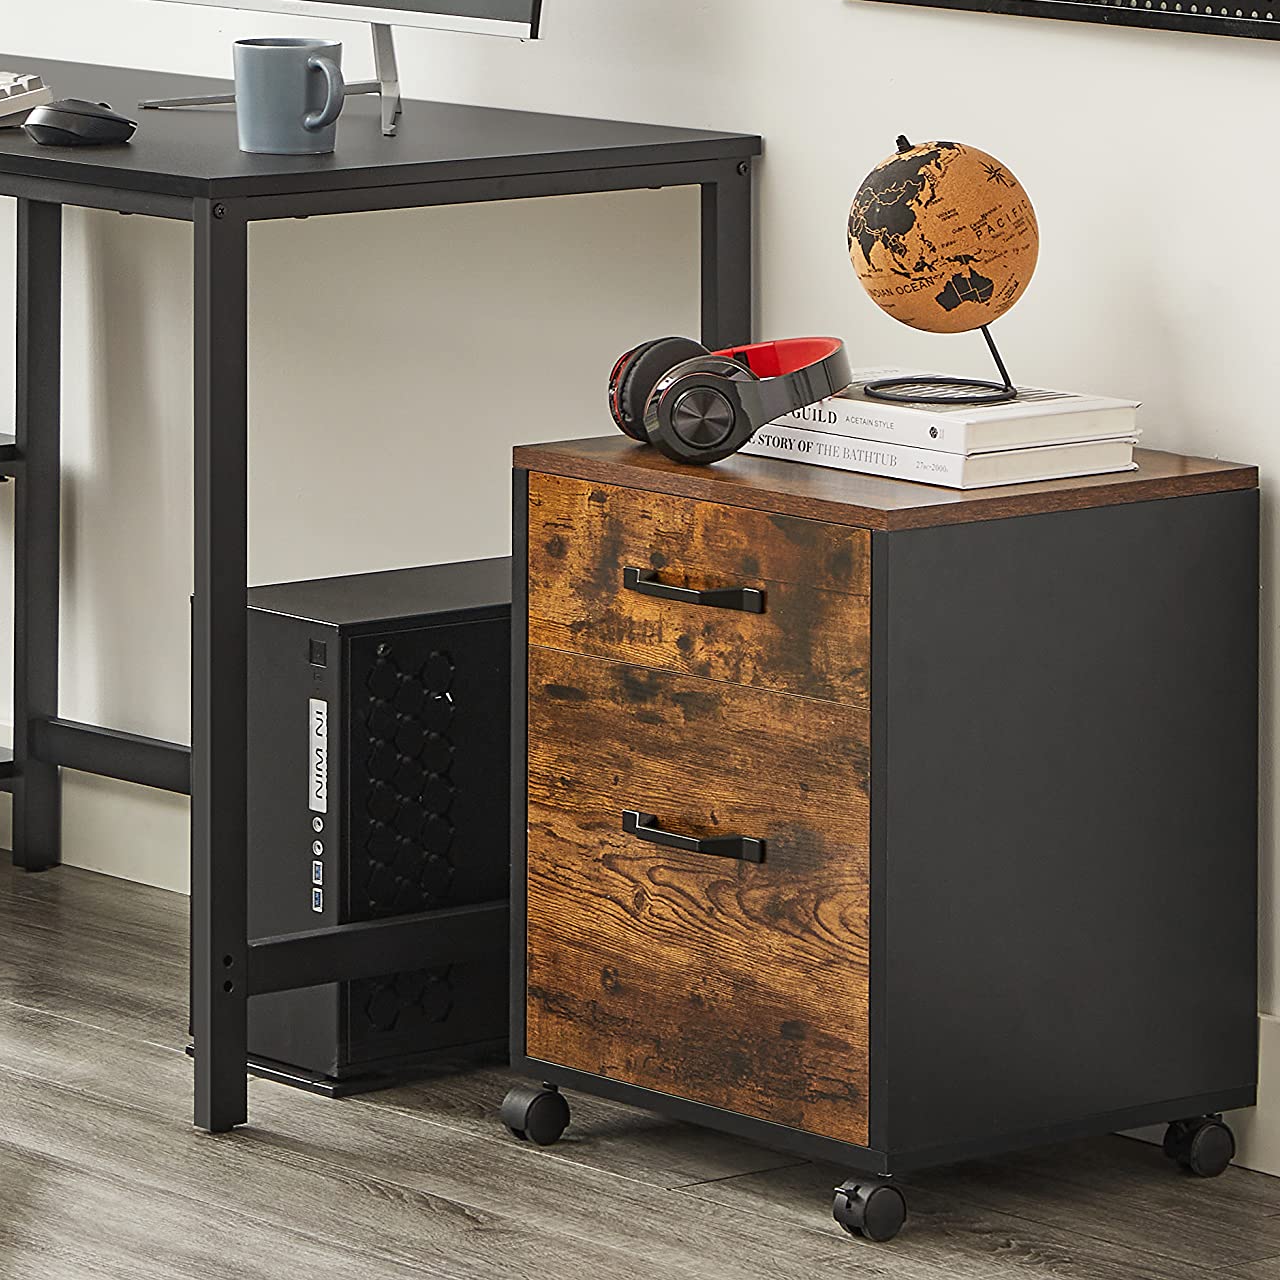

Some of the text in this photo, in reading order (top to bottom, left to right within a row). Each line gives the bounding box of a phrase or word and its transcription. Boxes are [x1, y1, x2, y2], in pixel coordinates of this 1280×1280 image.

[976, 200, 1028, 240] PACIFIC
[896, 278, 935, 295] OCEAN
[792, 407, 837, 424] GUILD
[875, 420, 895, 430] STYLE
[758, 434, 795, 451] STORY
[798, 440, 814, 453] OF
[816, 442, 840, 457] THE
[843, 447, 897, 466] BATHTUB
[316, 711, 324, 799] IN WIN
